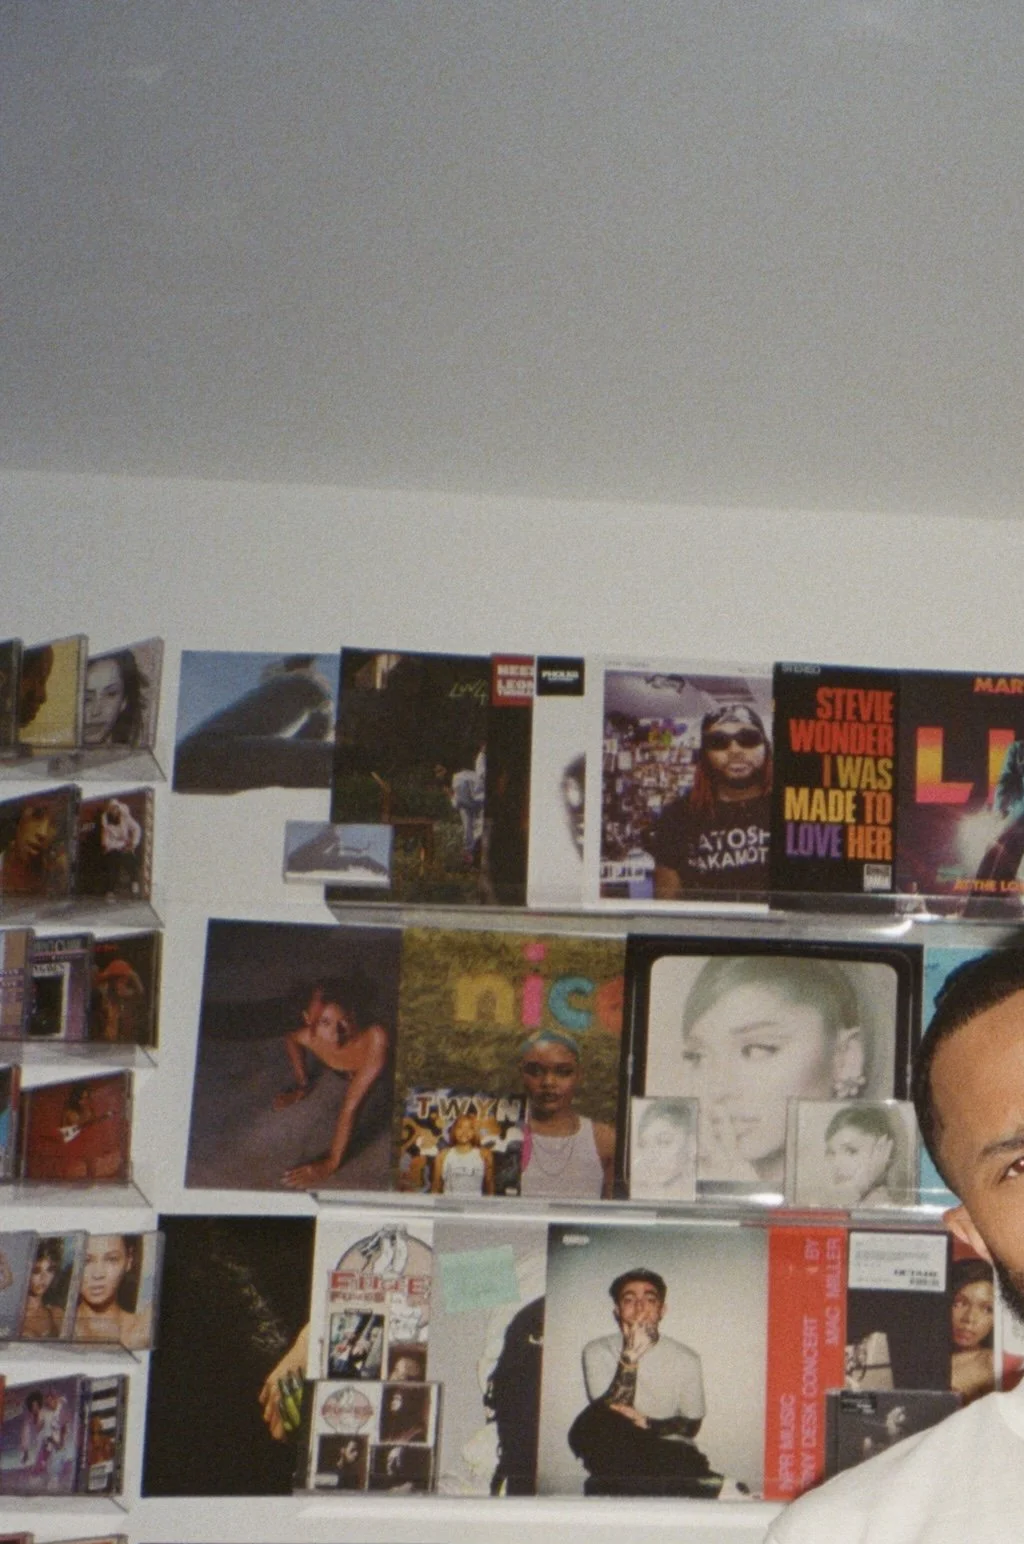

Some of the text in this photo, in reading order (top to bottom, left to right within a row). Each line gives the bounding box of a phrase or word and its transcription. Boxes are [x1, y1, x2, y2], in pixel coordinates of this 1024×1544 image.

[816, 688, 896, 723] STEVIE
[790, 719, 894, 756] WONDER
[822, 757, 893, 790] I WAS
[784, 788, 892, 824] MADE TO
[785, 822, 893, 860] LOVE HER
[825, 1237, 842, 1346] MAC MILLER
[802, 1315, 820, 1397] CONCERT
[779, 1393, 797, 1450] MUSIC
[801, 1403, 817, 1448] DESK
